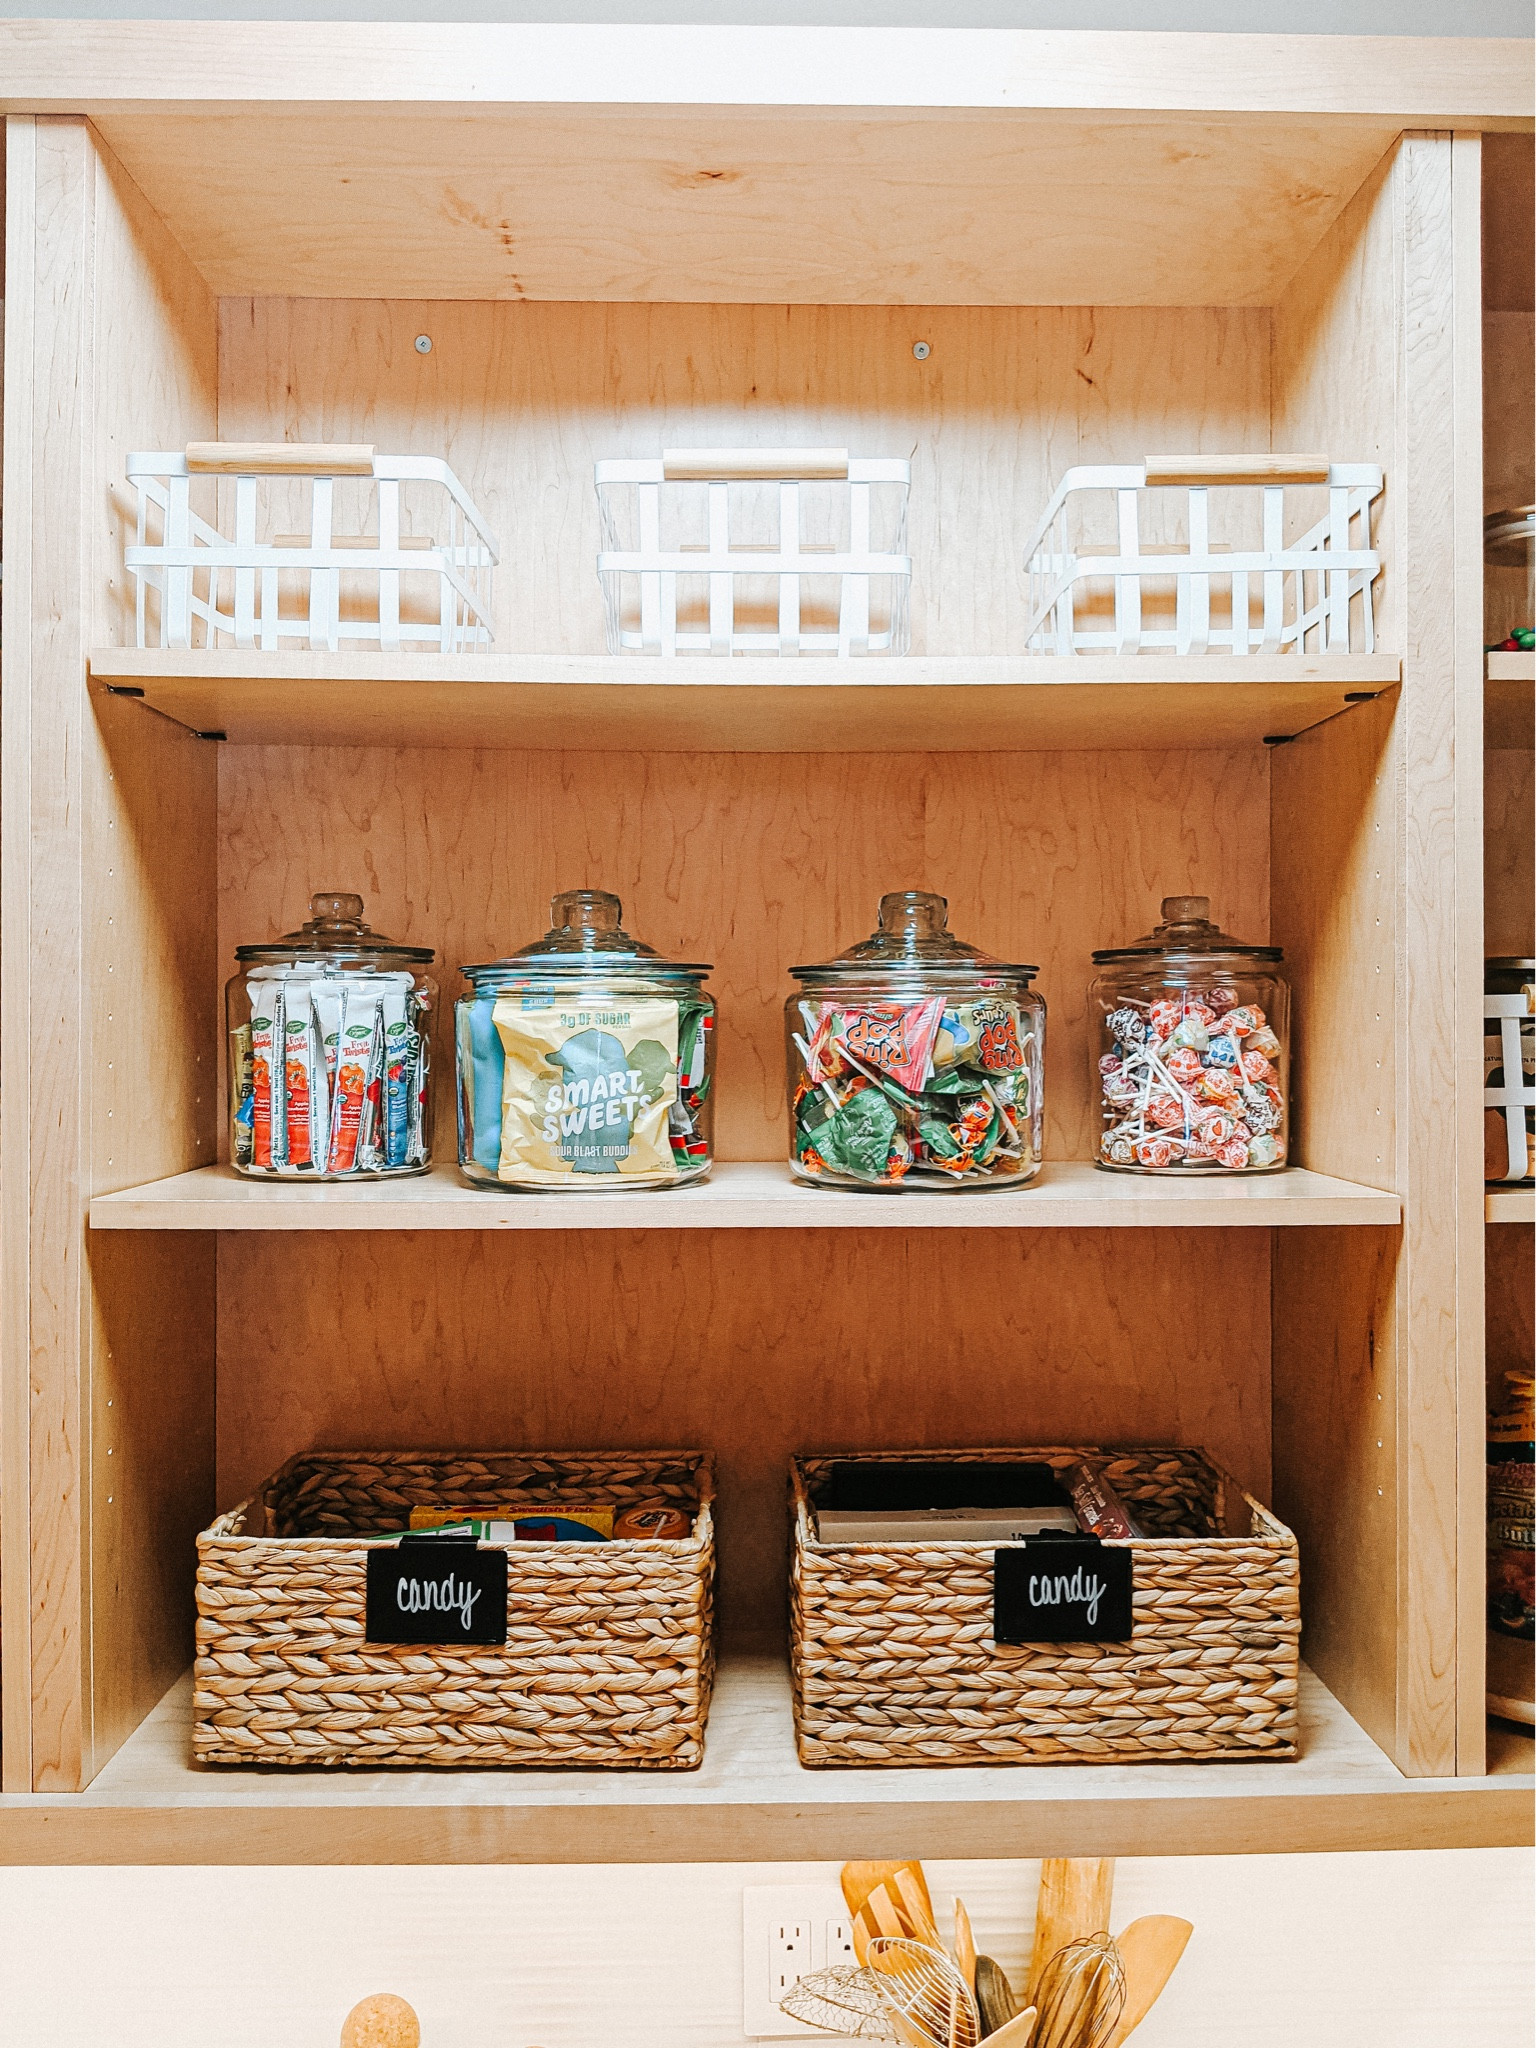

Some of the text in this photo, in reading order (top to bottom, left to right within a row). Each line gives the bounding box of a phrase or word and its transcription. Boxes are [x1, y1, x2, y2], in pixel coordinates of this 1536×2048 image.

[560, 1012, 631, 1028] 3g OF SUGAR
[343, 1048, 370, 1056] Twists
[981, 1040, 1025, 1071] Ring
[544, 1069, 645, 1113] SMART
[541, 1094, 652, 1142] SWEETS
[549, 1145, 572, 1157] SOUR
[573, 1145, 601, 1157] BLAST
[508, 1505, 594, 1513] Swedish Fish
[397, 1572, 482, 1630] candy
[1029, 1565, 1106, 1625] candy
